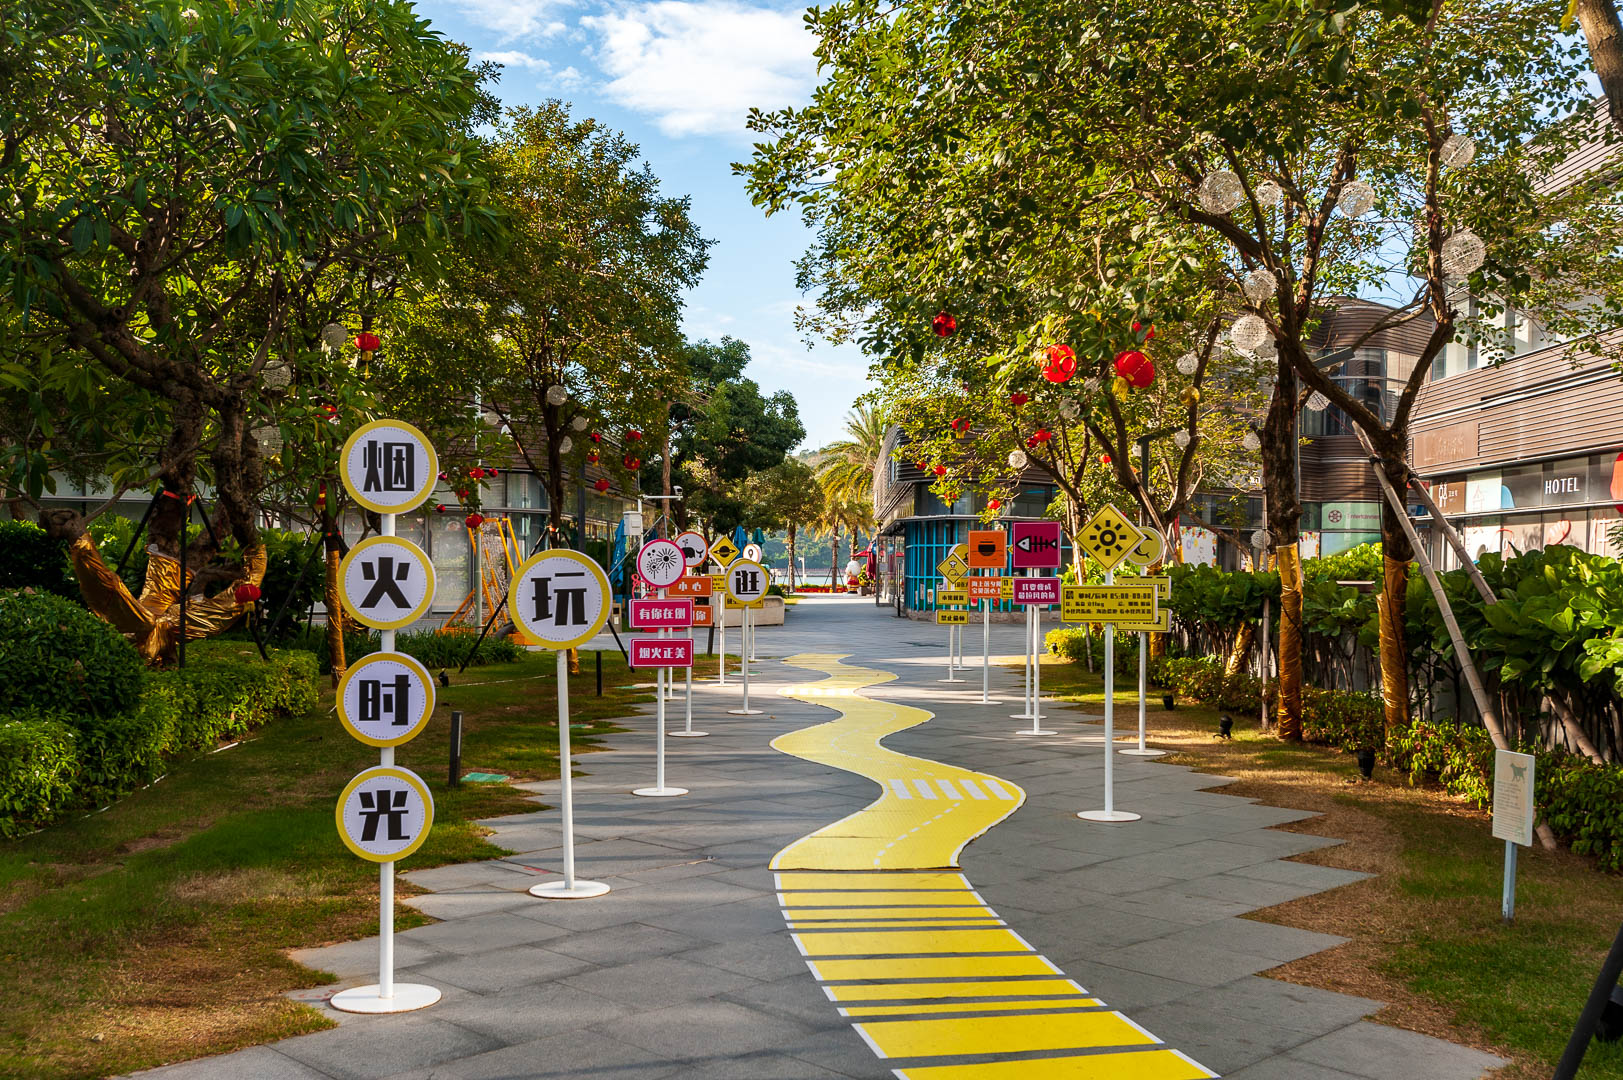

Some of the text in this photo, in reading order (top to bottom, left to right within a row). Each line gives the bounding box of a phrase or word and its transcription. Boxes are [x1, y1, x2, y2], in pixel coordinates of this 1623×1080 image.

[362, 440, 415, 492] 烟
[1544, 477, 1580, 496] HOTEL
[360, 556, 411, 609] 火
[530, 572, 589, 626] 玩
[678, 581, 702, 592] 小心
[735, 570, 760, 595] 逛
[638, 607, 686, 621] 有你在侧
[638, 647, 686, 659] 烟火正美
[358, 674, 411, 726] 时
[358, 789, 411, 842] 光
